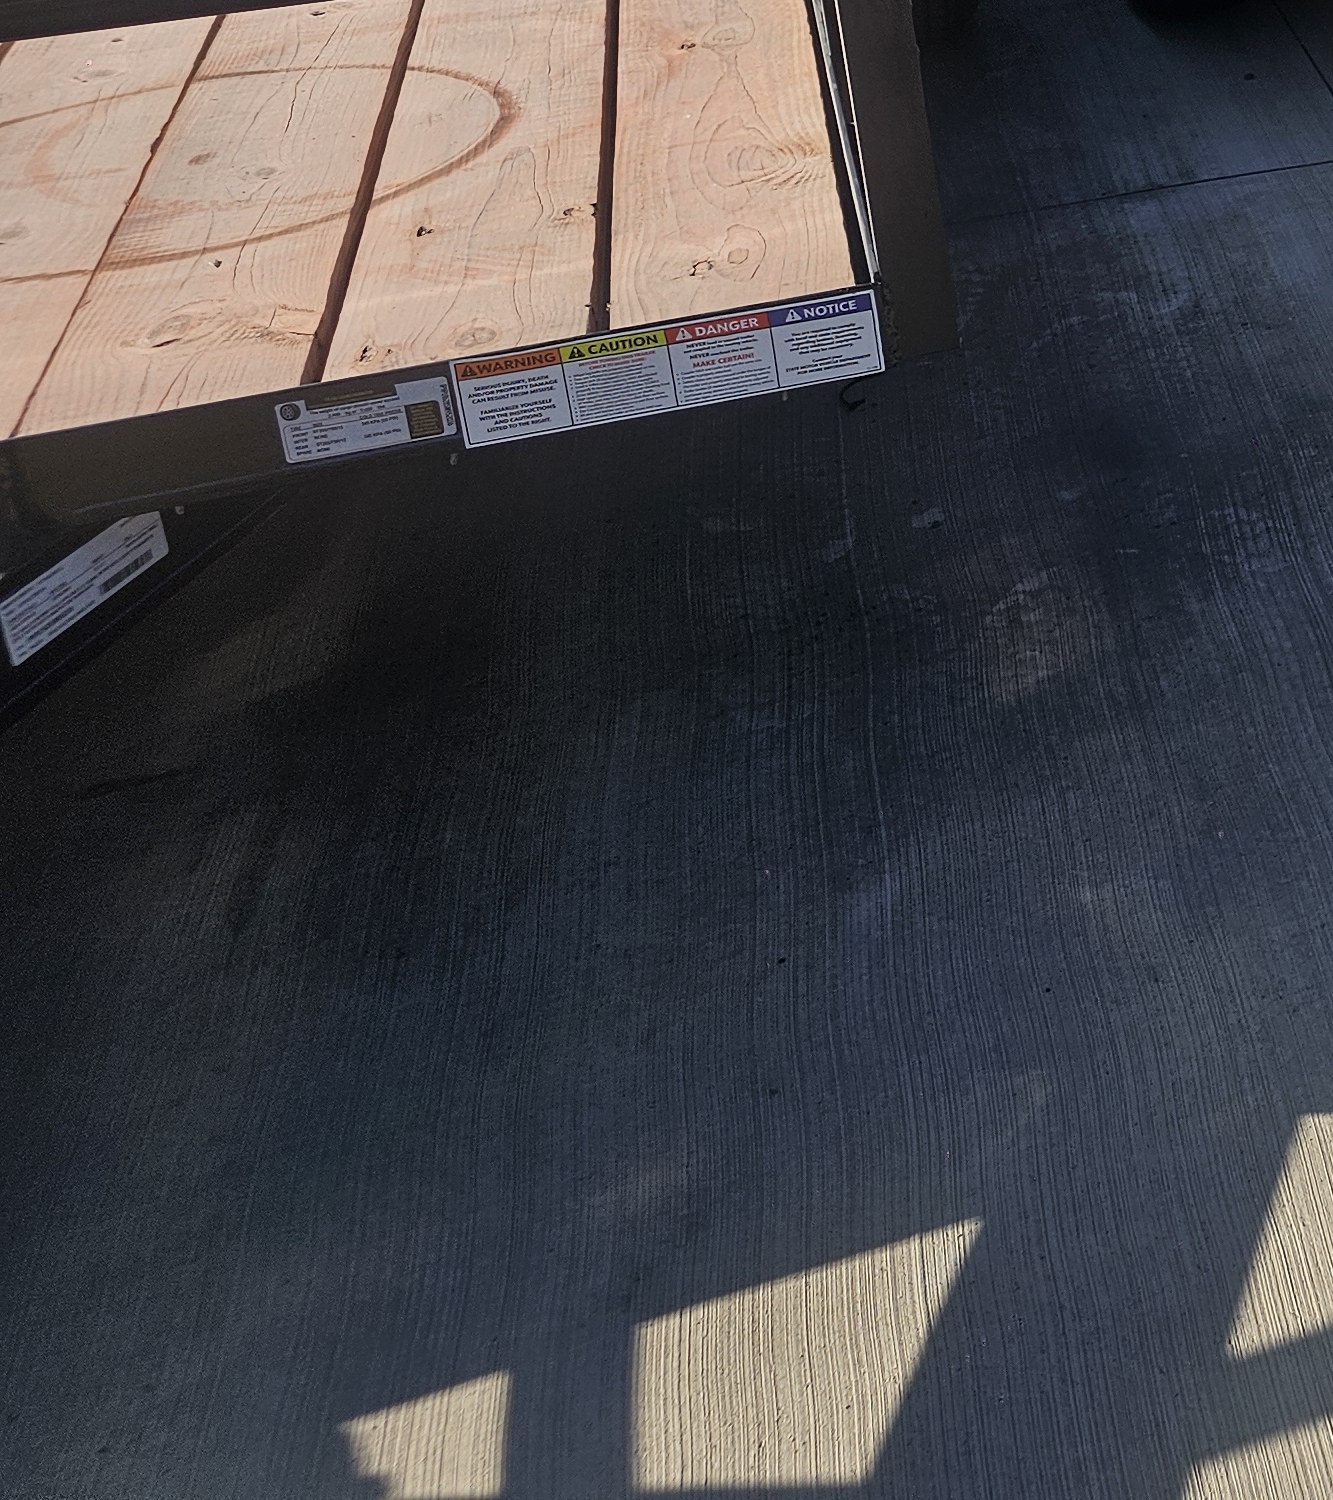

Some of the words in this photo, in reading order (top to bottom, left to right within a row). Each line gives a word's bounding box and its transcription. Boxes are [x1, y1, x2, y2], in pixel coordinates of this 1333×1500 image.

[803, 299, 857, 319] NOTICE
[694, 317, 759, 337] DANGER
[587, 334, 659, 355] CAUTION
[686, 341, 707, 349] NEVER
[476, 352, 557, 375] WARNING
[690, 352, 710, 360] NEVER
[692, 359, 716, 369] MAKE
[717, 353, 755, 365] CERTAIN!
[468, 390, 496, 400] AND/OR
[496, 385, 529, 395] PROPERTY
[529, 379, 559, 389] DAMAGE
[474, 382, 502, 392] SERIOUS
[472, 397, 487, 405] CAN
[520, 398, 553, 408] YOURSELF
[479, 413, 496, 422] WITH
[509, 404, 557, 417] INSTRUCTIONS
[494, 418, 510, 426] AND
[510, 412, 544, 423] CAUTIONS
[487, 424, 509, 433] LISTED
[518, 419, 530, 427] THE
